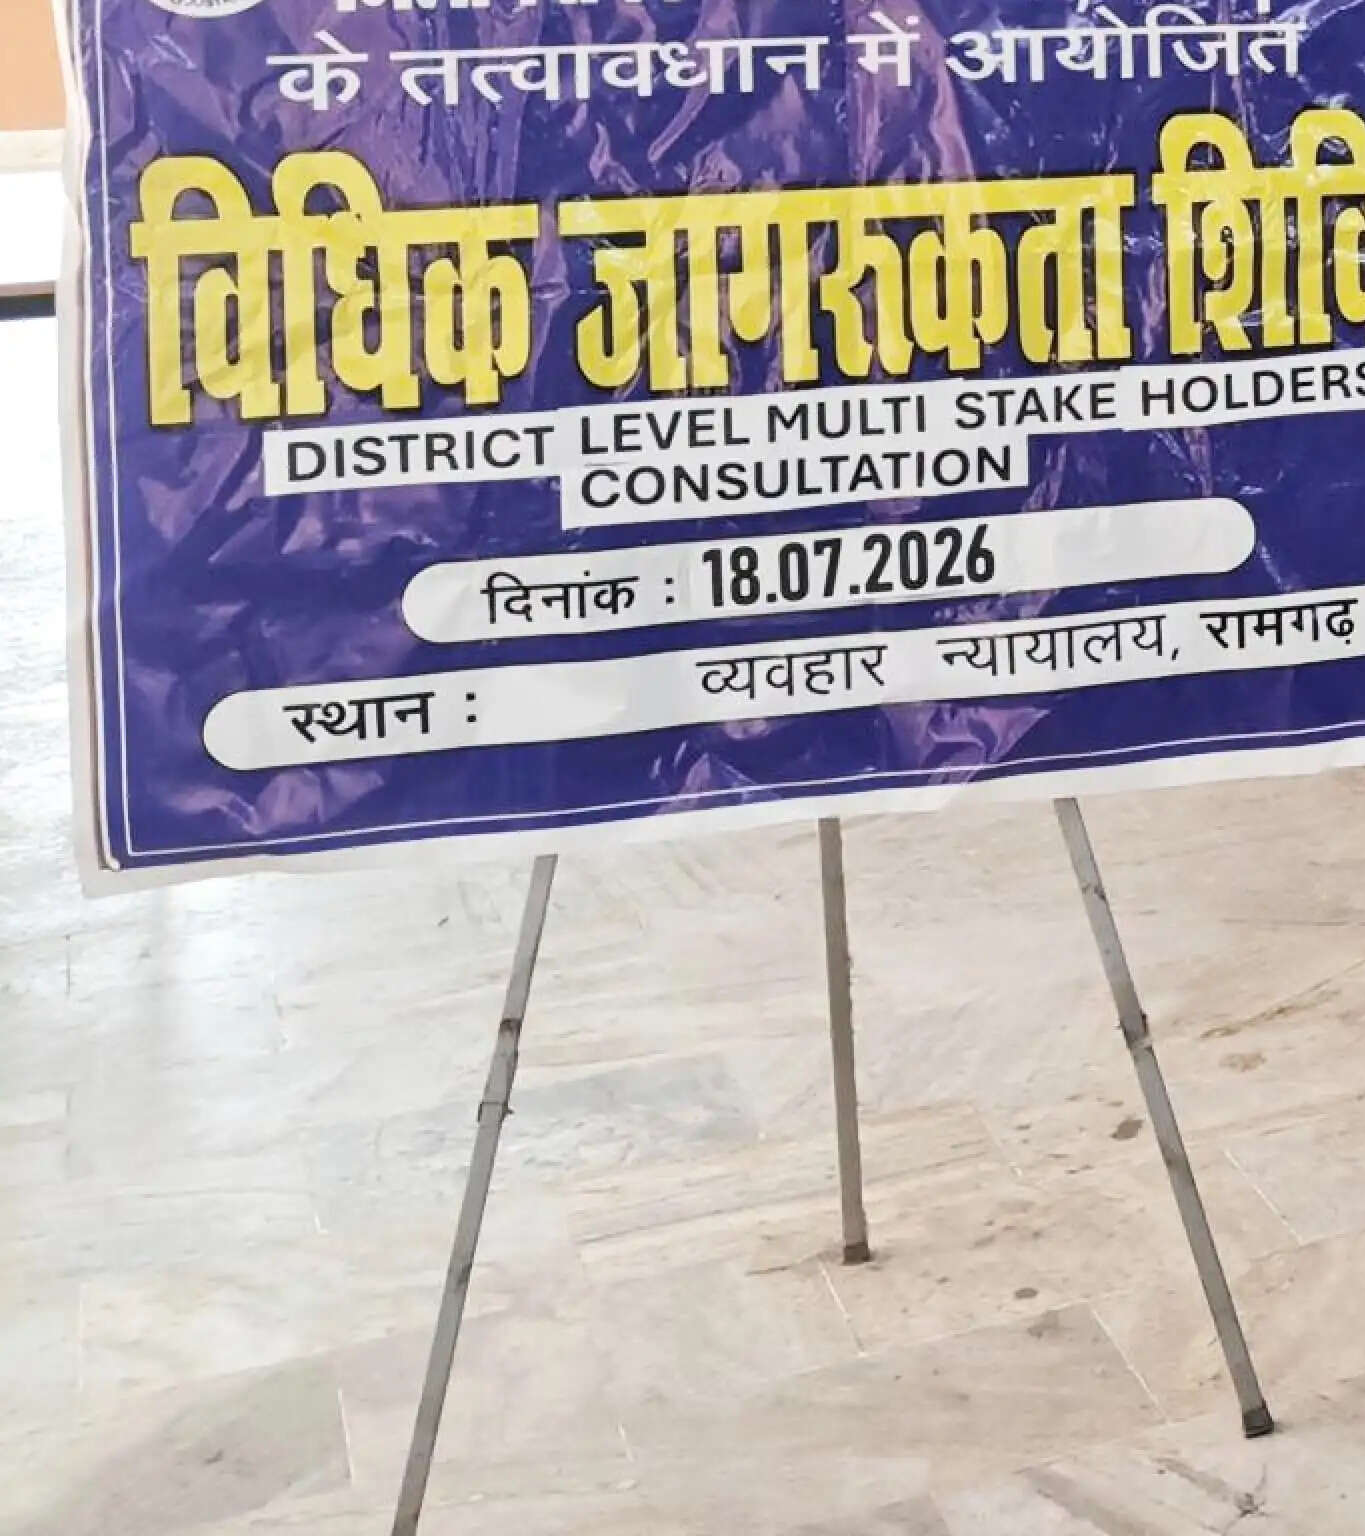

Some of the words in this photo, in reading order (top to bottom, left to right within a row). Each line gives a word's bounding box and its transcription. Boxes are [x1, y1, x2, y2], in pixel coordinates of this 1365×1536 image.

[266, 29, 369, 112] के
[389, 35, 830, 107] तत्वावधान
[846, 11, 919, 88] में
[946, 4, 1307, 83] आयोजित
[130, 150, 541, 429] विधिक
[286, 423, 556, 483] DISTRICT
[579, 406, 751, 457] LEVEL
[766, 391, 927, 444] MULTI
[954, 381, 1118, 430] STAKE
[580, 443, 1014, 509] CONSULTATION
[480, 570, 639, 625] दिनांक
[701, 523, 997, 609] 18.07.2026
[284, 690, 435, 744] स्थान
[695, 643, 888, 702] व्यवहार
[936, 613, 1181, 678] न्यायालय,
[1199, 596, 1358, 648] रामगढ़
